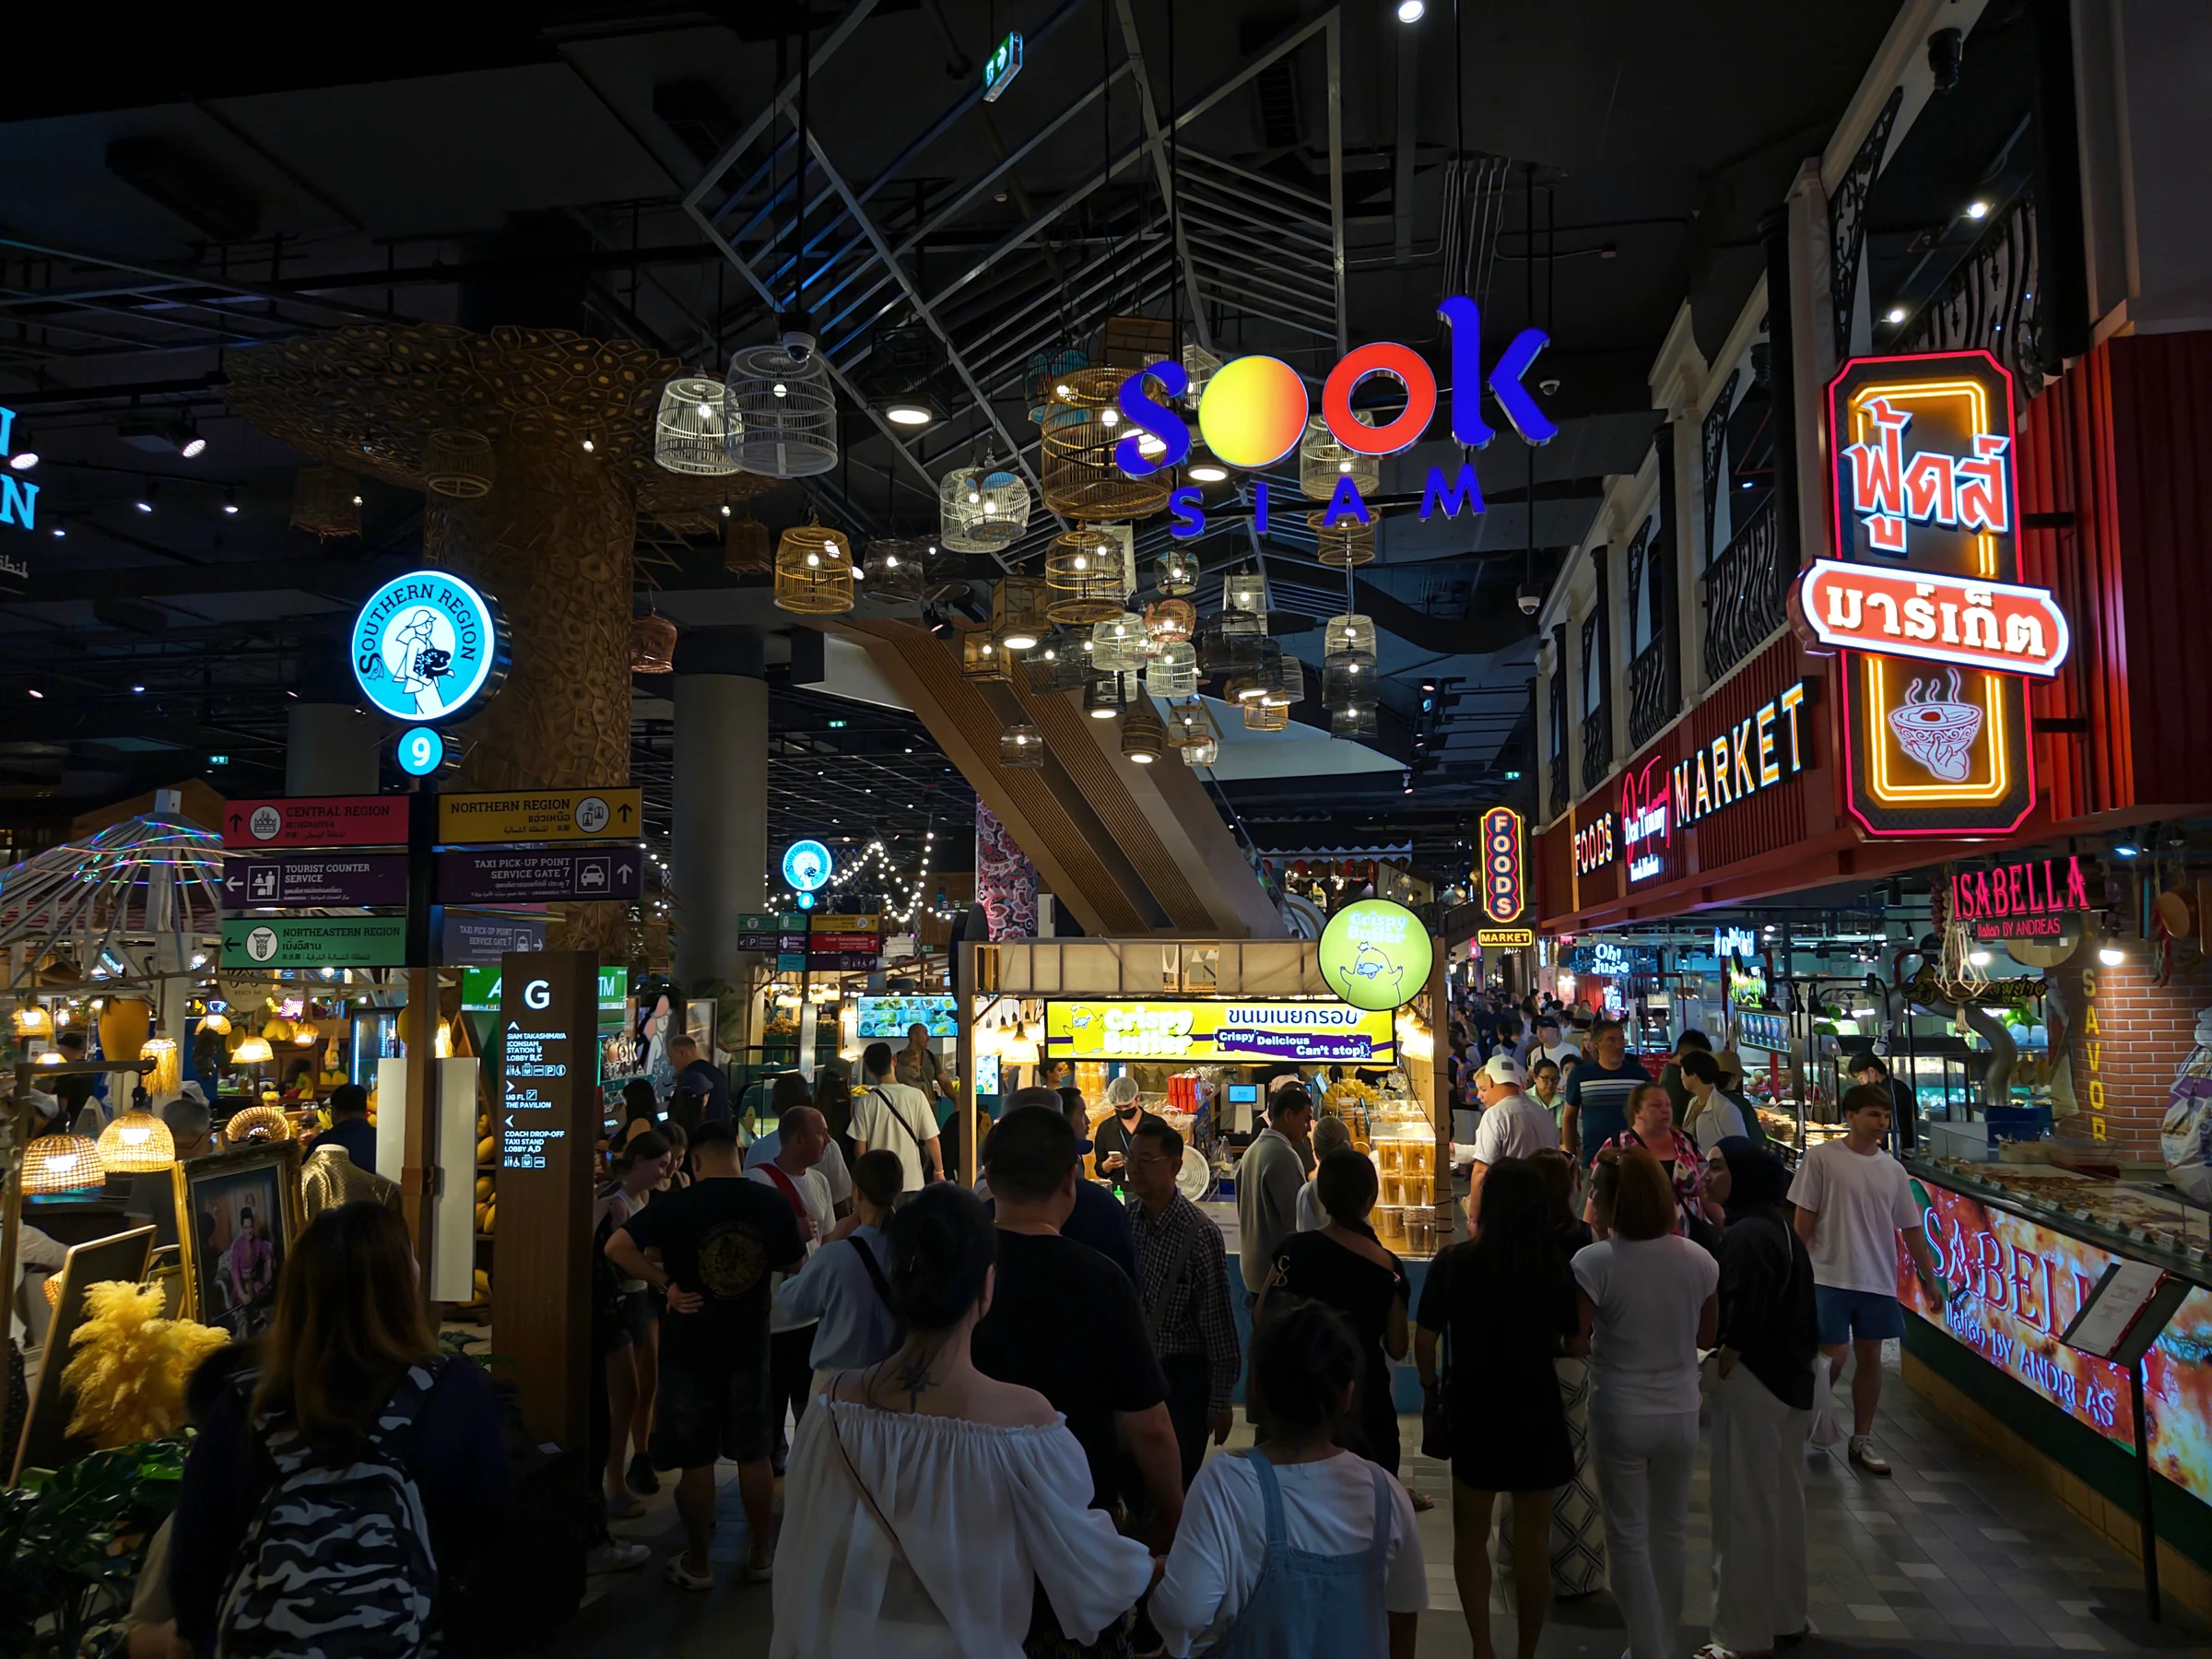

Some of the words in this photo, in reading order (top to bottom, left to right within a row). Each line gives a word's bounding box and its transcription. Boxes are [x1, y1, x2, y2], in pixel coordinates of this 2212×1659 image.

[1168, 464, 1487, 540] SIAM
[359, 583, 435, 675] SOUTHERN
[438, 588, 477, 662] REGION
[1826, 582, 2048, 657] มาร์เก็ต
[411, 736, 431, 767] 9
[1673, 682, 1805, 829] MARKET
[286, 806, 341, 818] CENTRAL
[345, 806, 390, 817] REGION
[451, 800, 520, 814] NORTHERN
[523, 798, 571, 811] REGION
[1574, 812, 1614, 877] FOODS
[285, 865, 324, 874] TOURIST
[326, 864, 371, 873] COUNTER
[474, 859, 497, 868] TAXI
[499, 858, 538, 867] PICK-UP
[540, 857, 571, 866] POINT
[490, 869, 533, 879] SERVICE
[534, 868, 561, 878] GATE
[562, 867, 571, 877] 7
[1494, 815, 1512, 914] FOODS
[285, 875, 324, 883] SERVICE
[1950, 855, 2091, 921] ISABELLA
[283, 927, 361, 938] NORTHEASTERN
[363, 926, 401, 936] REGION
[1348, 910, 1408, 932] Crispy
[1976, 924, 2000, 937] Italian
[2002, 923, 2015, 936] BY
[2016, 917, 2062, 936] ANDREAS
[1347, 924, 1406, 945] Butter
[1480, 932, 1530, 943] MARKET
[1594, 943, 1622, 965] Oh!
[524, 980, 551, 1010] G
[1103, 1004, 1194, 1036] Crispy
[1228, 1008, 1359, 1025] ขนมเนยกรอบ
[1103, 1030, 1194, 1056] Butter
[1218, 1031, 1255, 1043] Crispy
[1256, 1036, 1311, 1045] Delicious
[1296, 1045, 1329, 1056] Can't
[1332, 1045, 1365, 1057] stop!
[1991, 1327, 2016, 1365] BY
